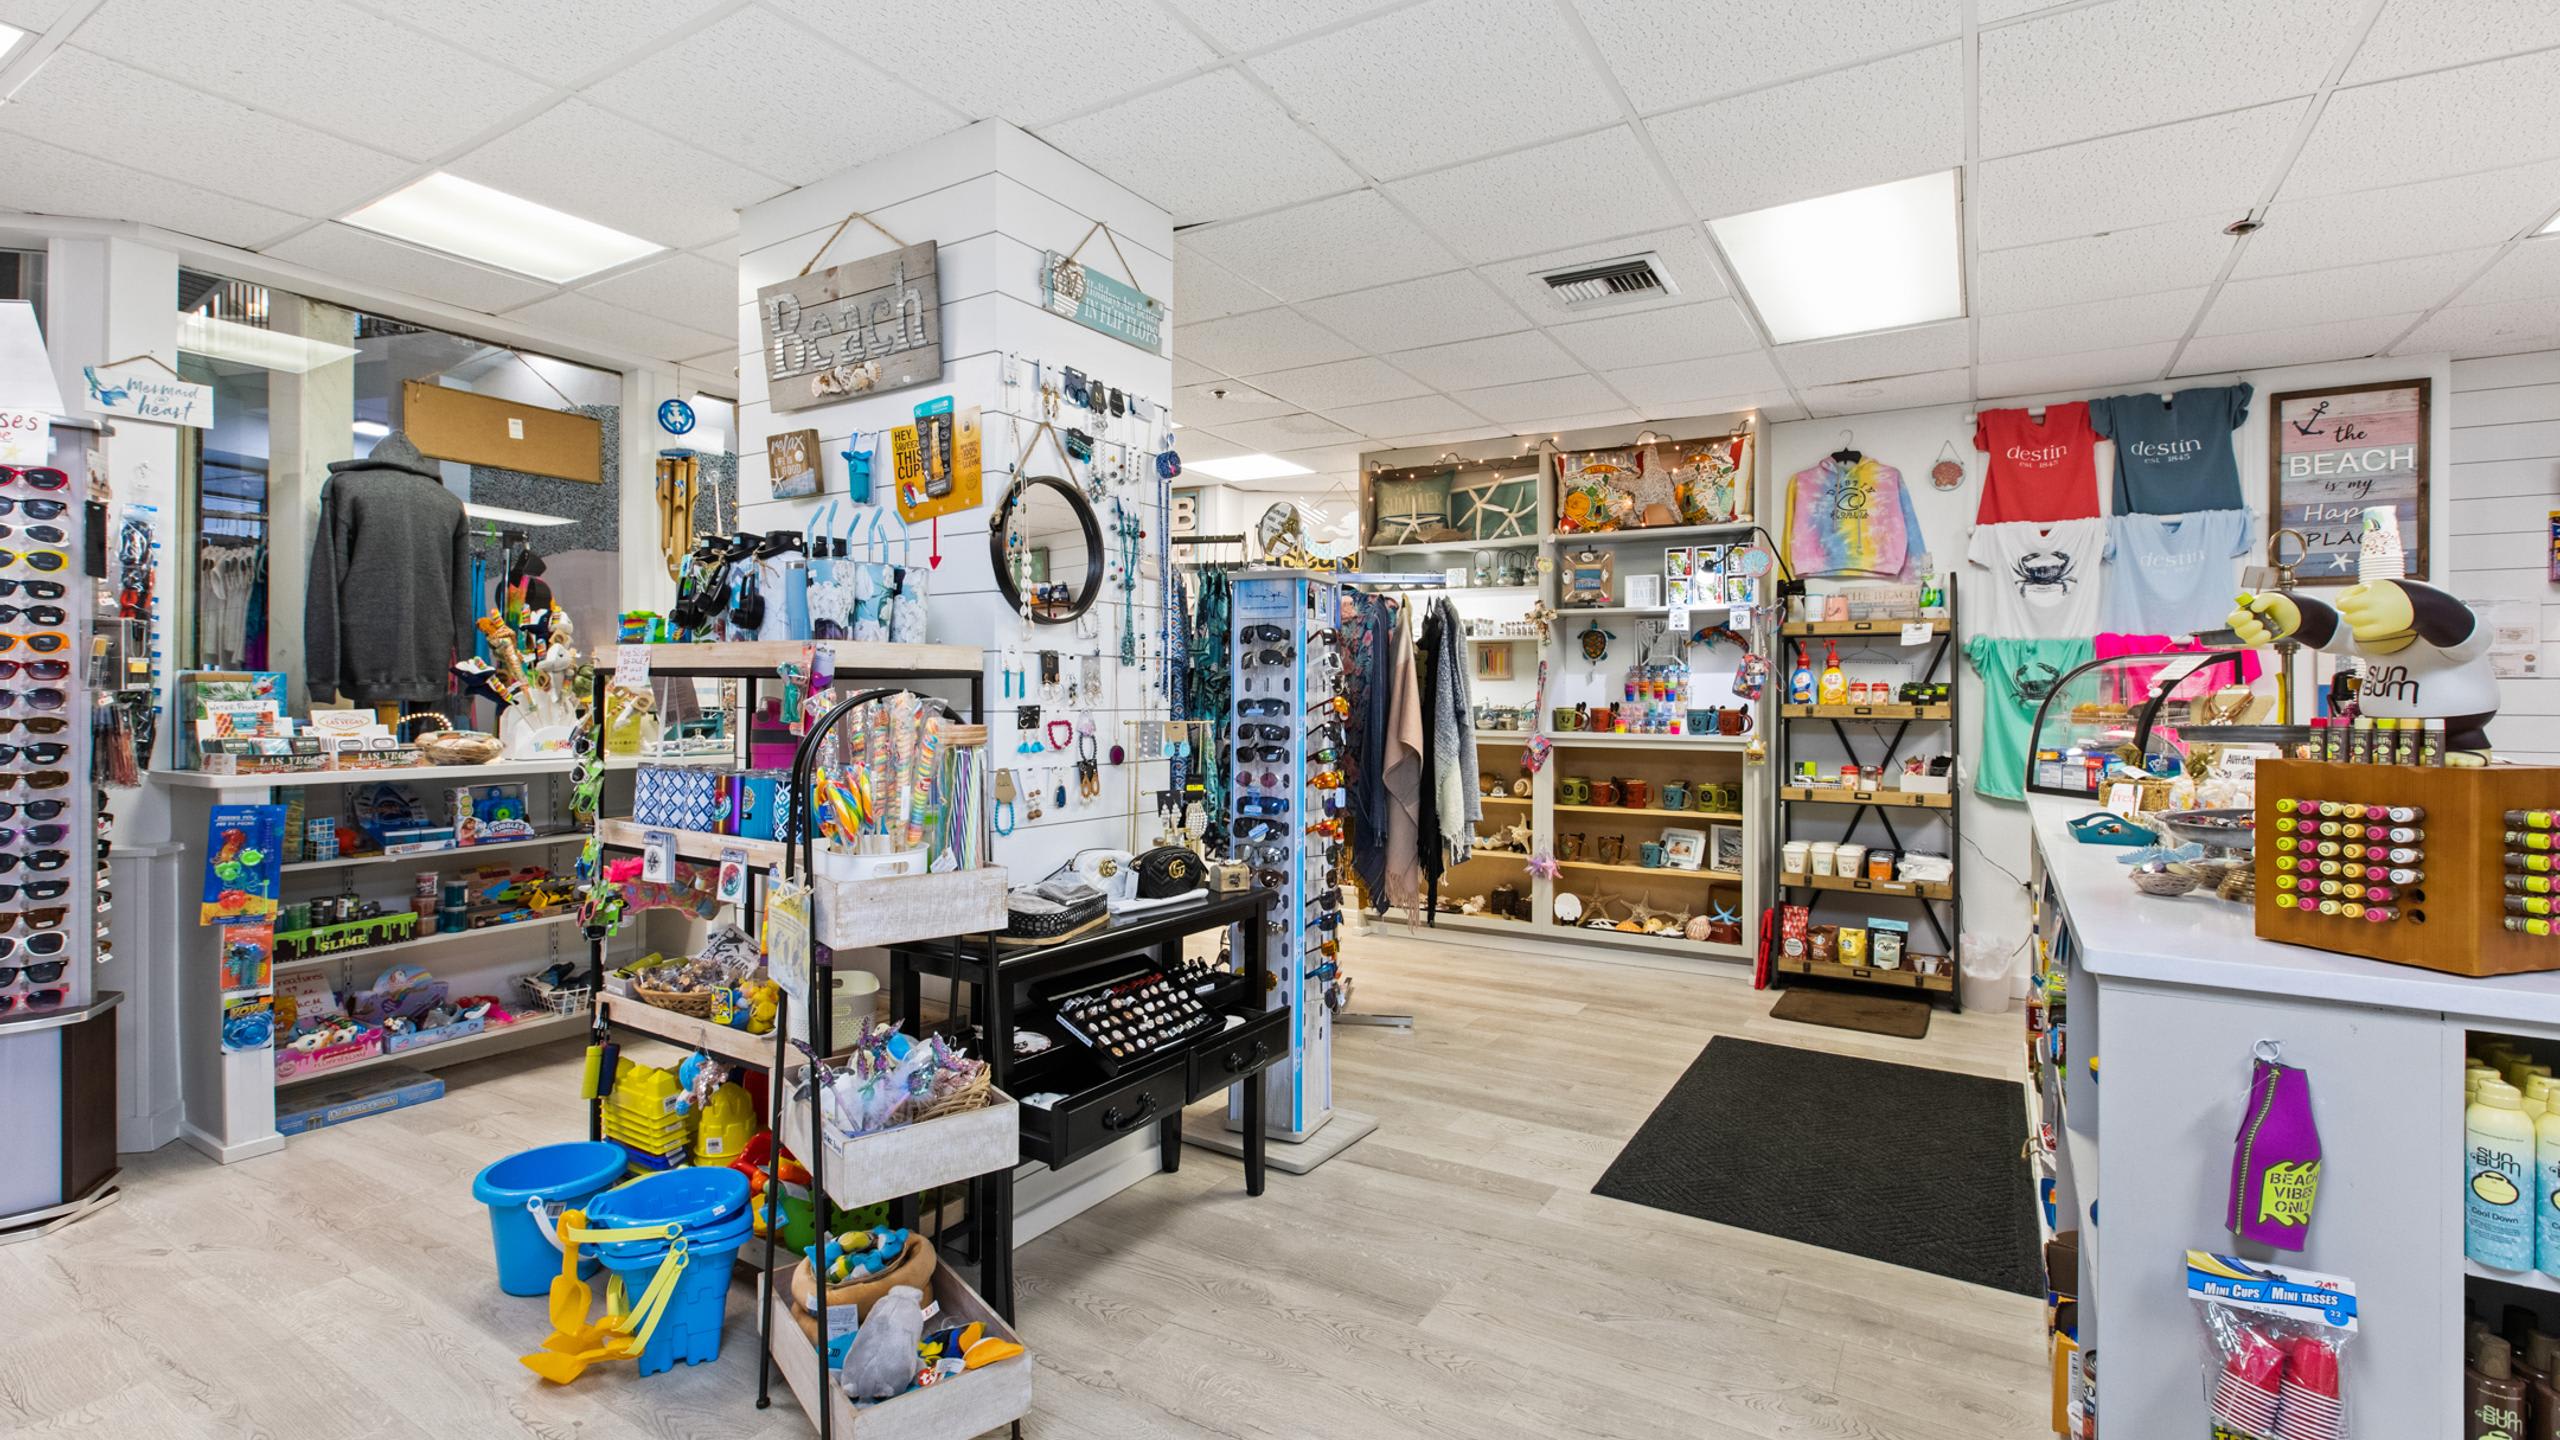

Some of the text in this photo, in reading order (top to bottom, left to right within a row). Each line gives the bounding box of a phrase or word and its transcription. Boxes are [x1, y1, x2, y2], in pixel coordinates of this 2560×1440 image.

[765, 261, 928, 380] Beach
[1085, 298, 1158, 345] IN FLIP FLOPS
[127, 377, 198, 400] mermaid
[137, 394, 195, 421] heart
[894, 429, 912, 441] HEY
[2334, 424, 2368, 443] the
[2007, 445, 2067, 461] destin
[2131, 440, 2202, 456] destin
[896, 449, 922, 466] THIS
[2289, 448, 2415, 478] BEACH
[2325, 479, 2373, 499] is my
[2140, 550, 2208, 568] destin
[1874, 590, 1918, 601] BEACH
[259, 754, 326, 766] LAS VEGAS
[358, 750, 418, 762] LAS VEGAS
[320, 935, 367, 951] SLIME
[2270, 1172, 2318, 1185] BEACH
[2275, 1186, 2313, 1198] VIBES
[2472, 1206, 2519, 1224] Cool Down
[2330, 1310, 2341, 1318] 22
